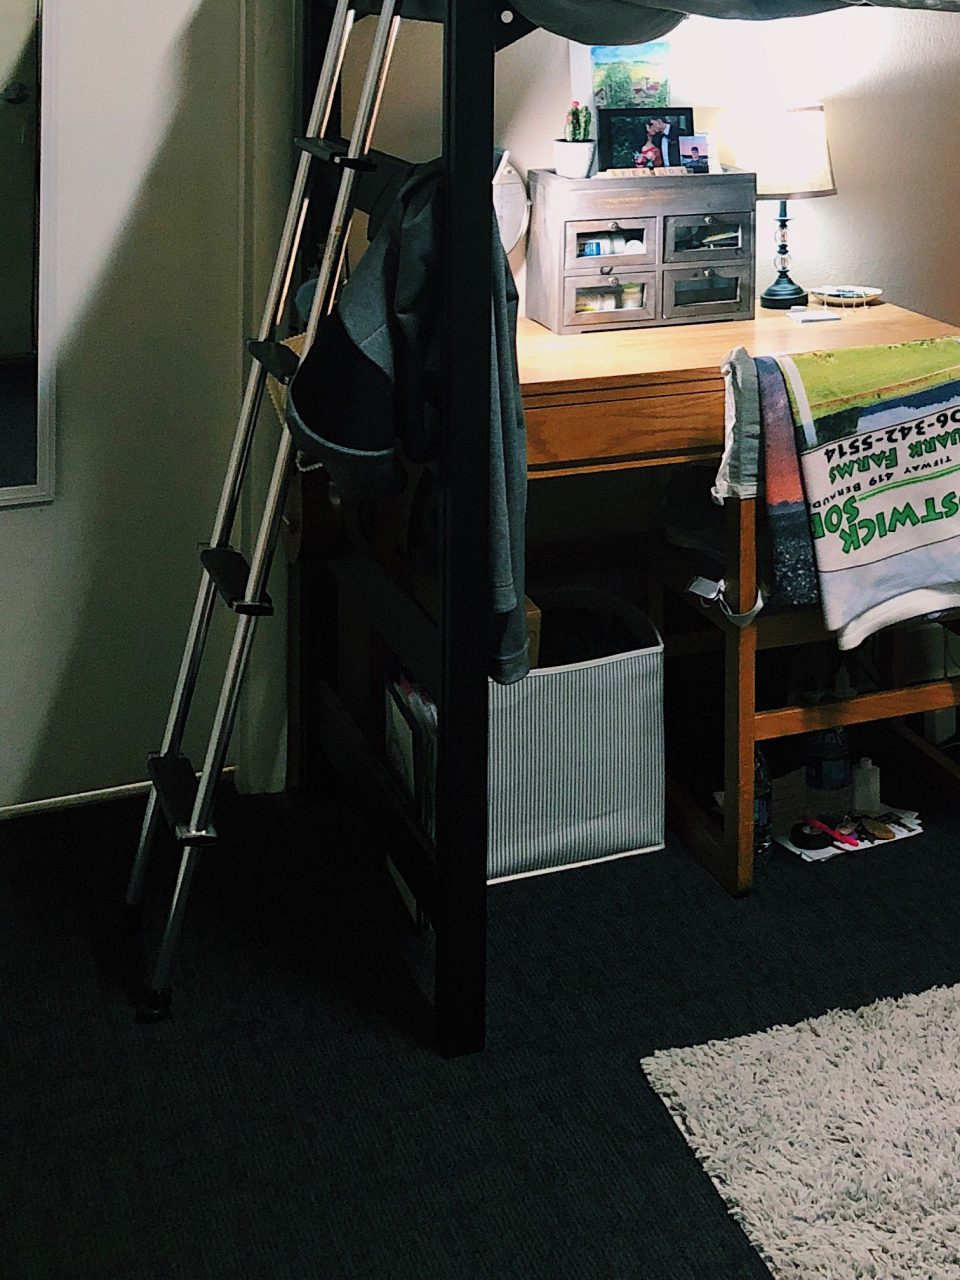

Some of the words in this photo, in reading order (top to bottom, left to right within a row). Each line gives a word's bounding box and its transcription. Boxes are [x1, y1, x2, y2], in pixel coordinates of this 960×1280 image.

[830, 448, 898, 483] FARMS
[904, 456, 952, 475] TIFWAY
[868, 472, 895, 487] 419
[808, 482, 862, 509] BERMUD
